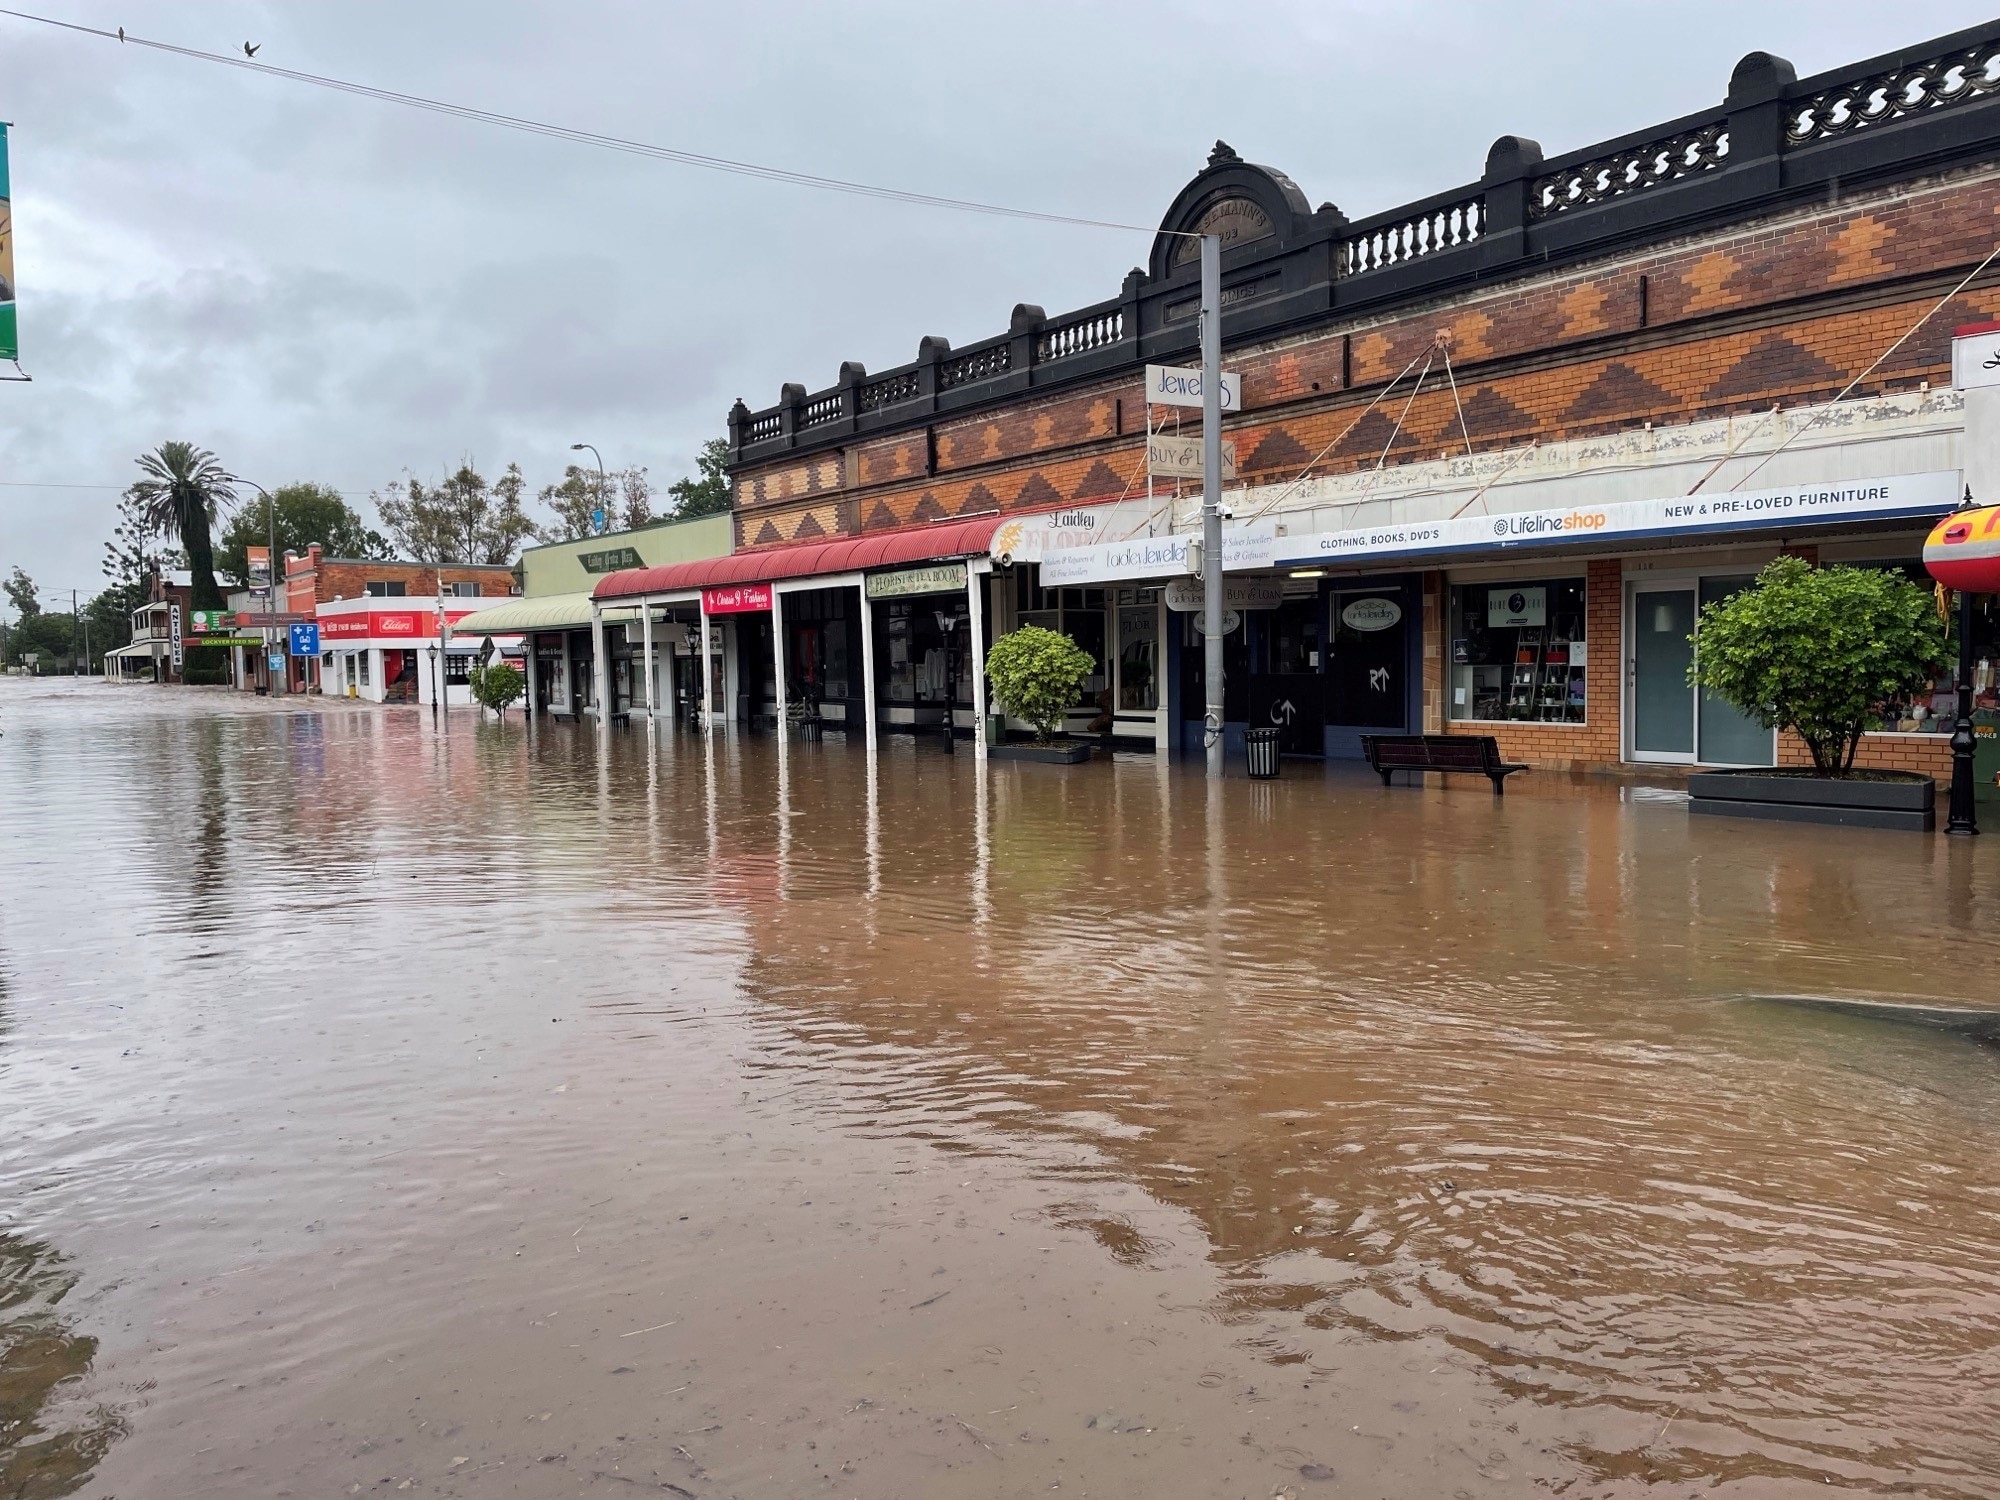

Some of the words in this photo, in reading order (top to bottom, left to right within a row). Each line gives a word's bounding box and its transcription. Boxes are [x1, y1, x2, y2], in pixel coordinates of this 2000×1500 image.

[1217, 227, 1238, 242] 903
[1150, 446, 1176, 463] BUY
[1178, 447, 1194, 466] &
[1196, 449, 1234, 467] LN
[1665, 505, 1694, 518] NEW
[1698, 504, 1708, 515] &
[1712, 496, 1793, 513] PRE-LOVED
[1799, 487, 1890, 506] FURNITURE
[1047, 509, 1095, 531] Laidley
[1320, 536, 1368, 549] CLOTHING,
[1371, 532, 1407, 545] BOOKS,
[1410, 529, 1440, 541] DVD'S
[875, 574, 906, 592] FLORIST
[1227, 588, 1247, 600] BUY
[1247, 586, 1256, 601] &
[1258, 589, 1282, 601] LOAN
[172, 607, 181, 663] ANTIQUES
[306, 626, 314, 634] P
[381, 619, 411, 631] Elders
[1369, 669, 1380, 692] R
